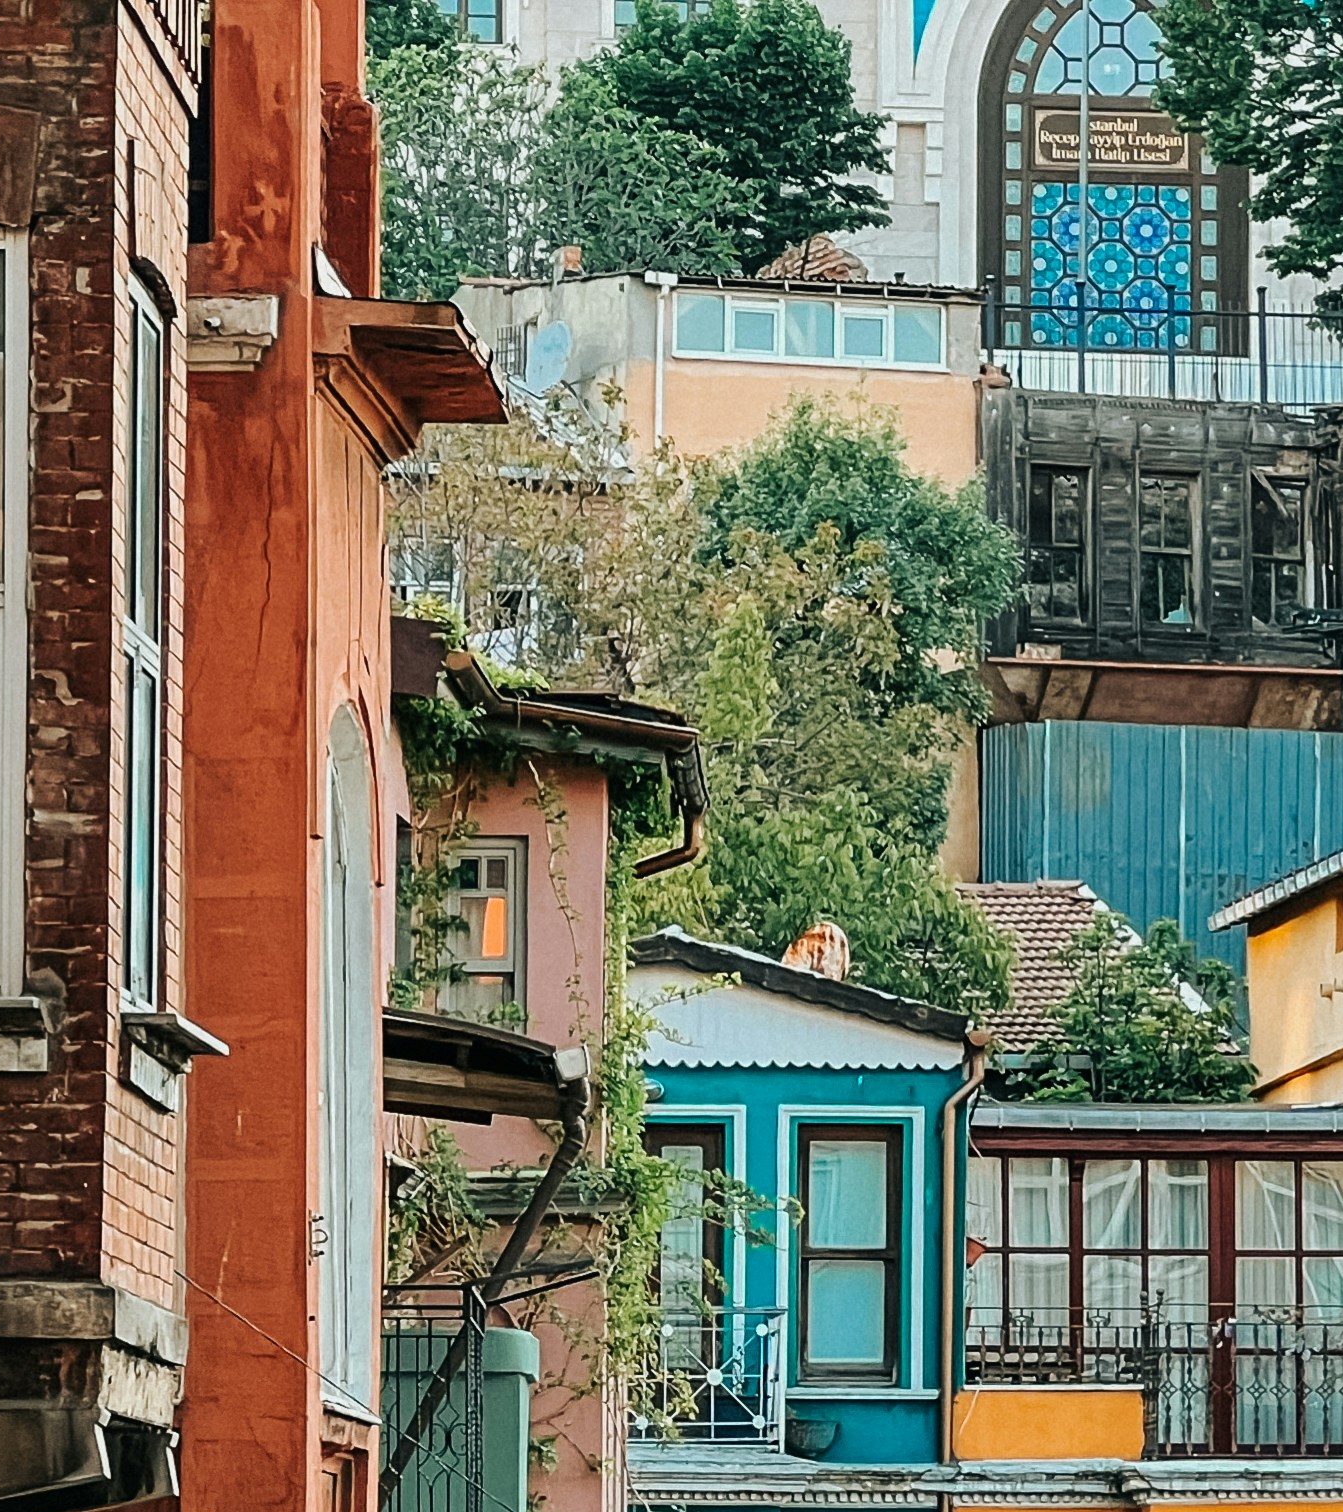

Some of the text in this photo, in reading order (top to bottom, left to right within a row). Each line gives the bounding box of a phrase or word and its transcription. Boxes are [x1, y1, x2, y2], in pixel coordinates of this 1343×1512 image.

[1088, 117, 1138, 132] stanbul
[1040, 131, 1183, 149] Recep ayyip Erdoğan
[1095, 148, 1130, 163] Hatip
[1133, 148, 1171, 162] Lisesi
